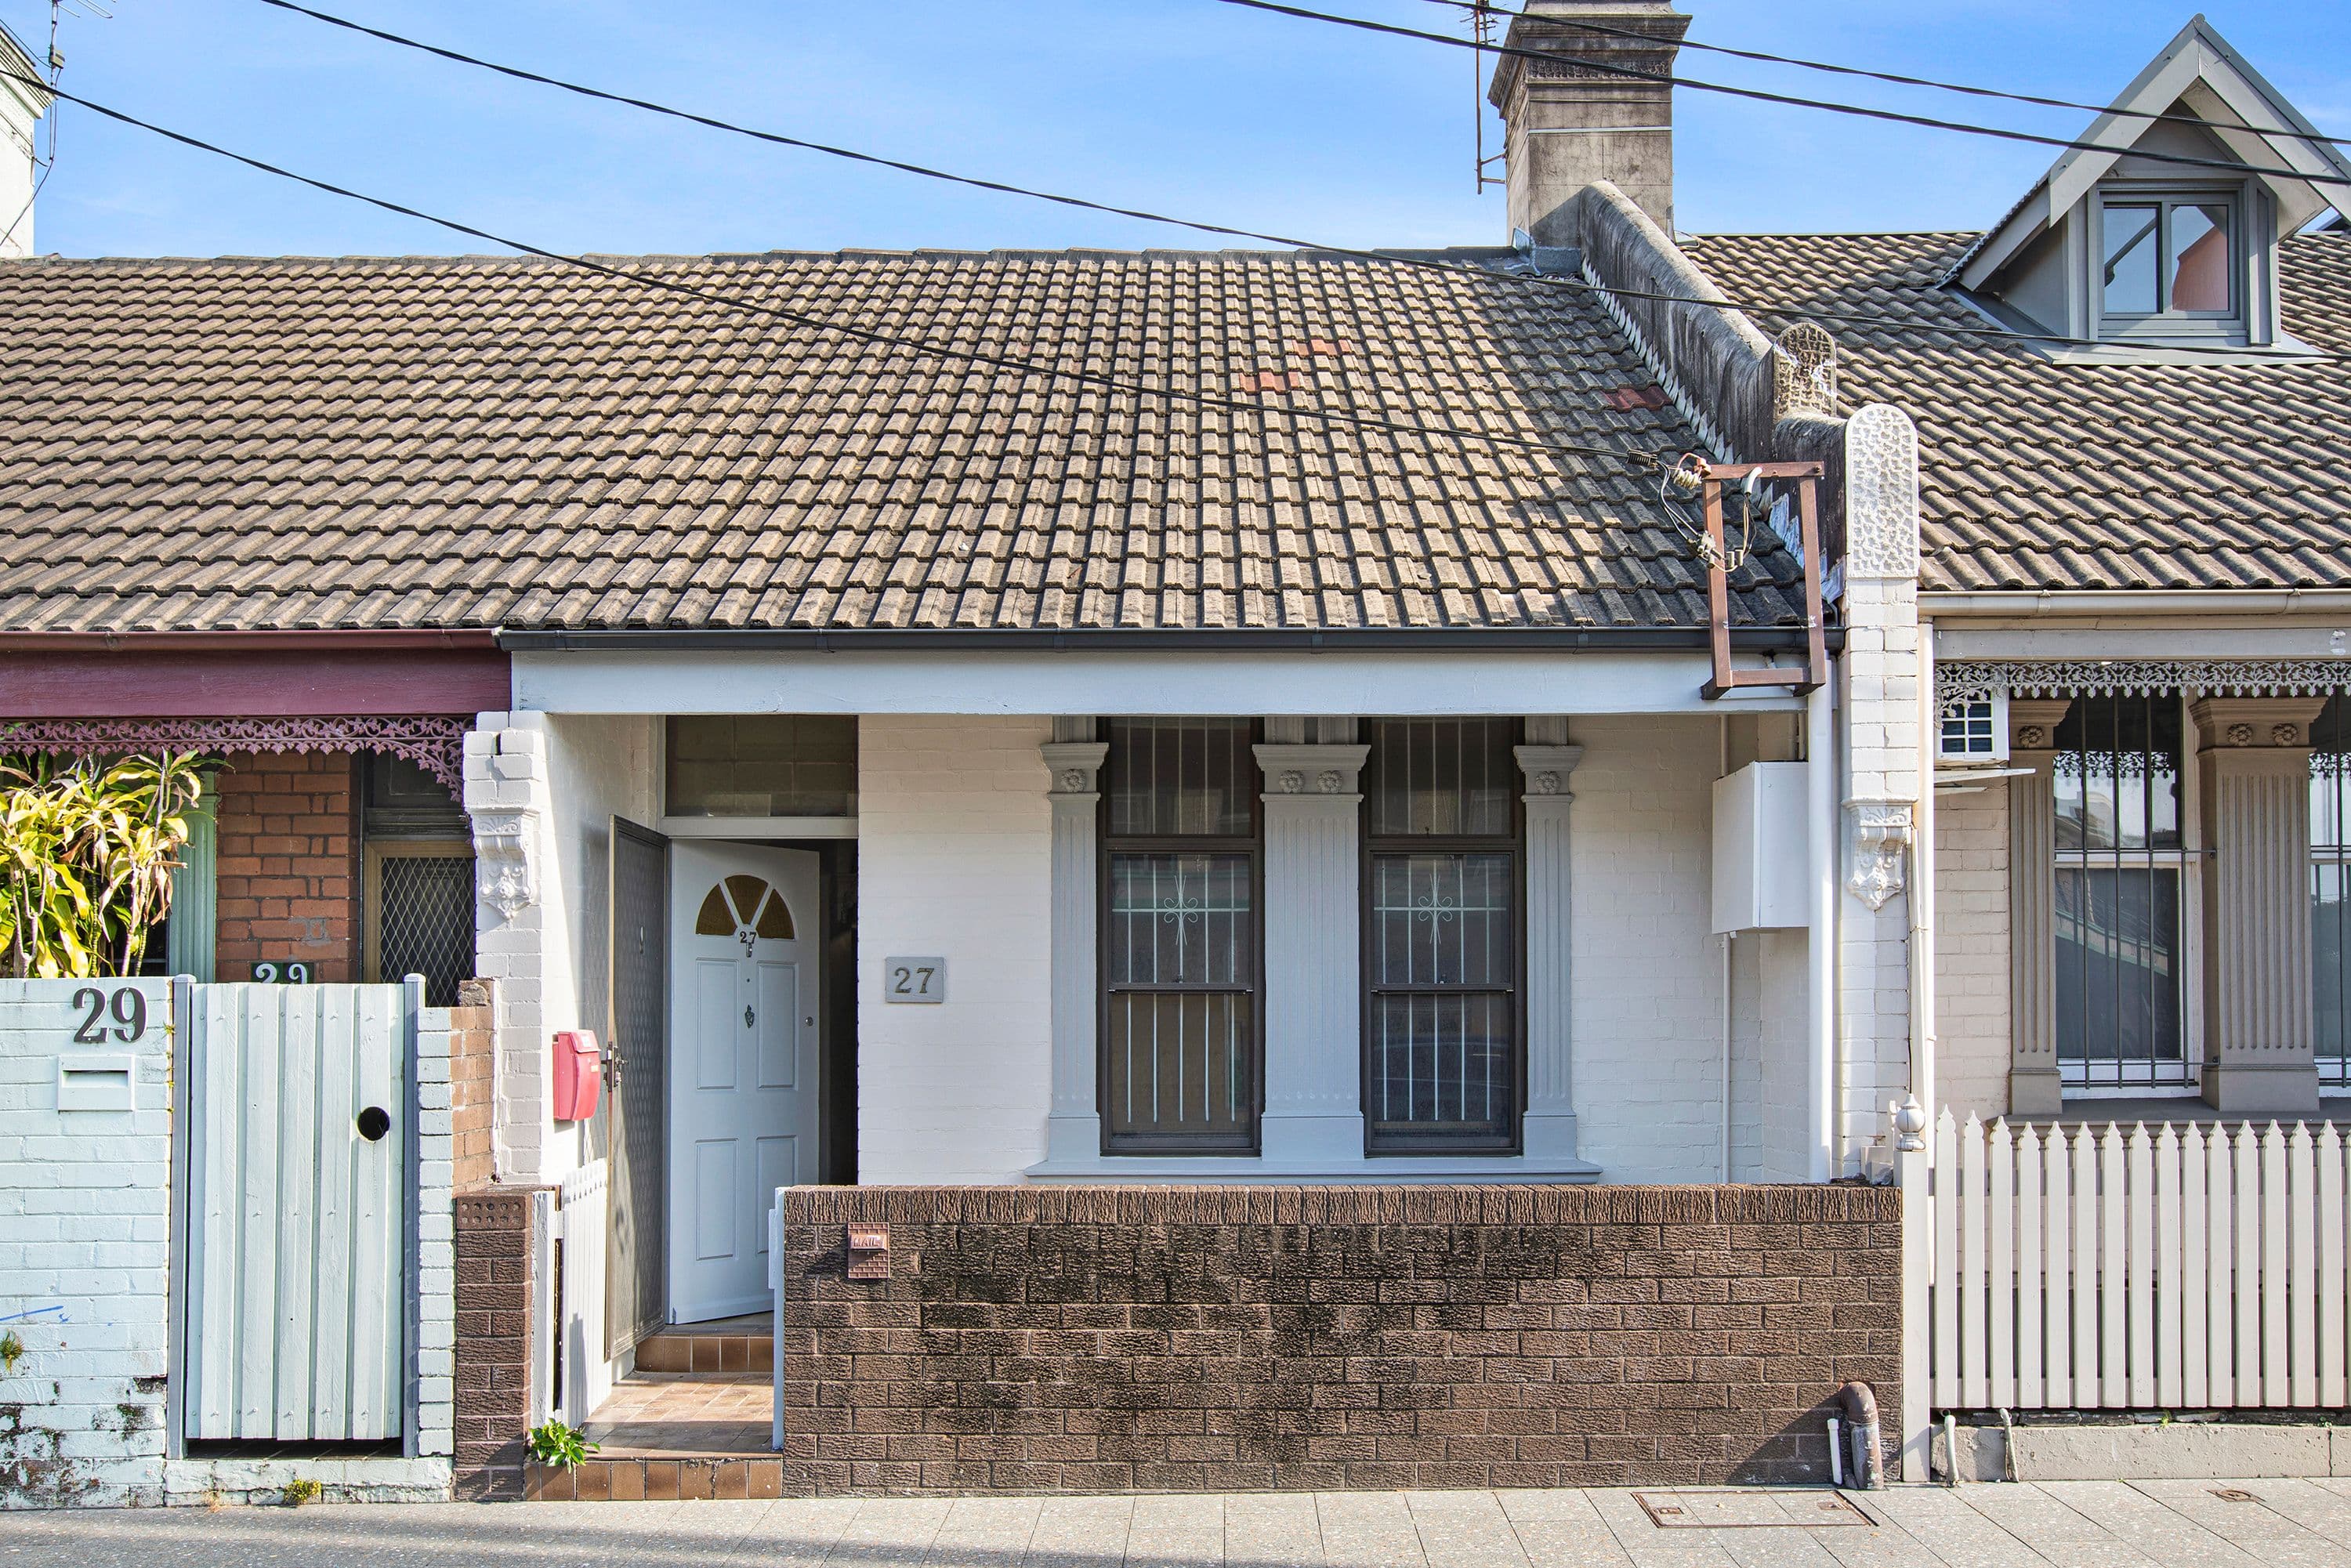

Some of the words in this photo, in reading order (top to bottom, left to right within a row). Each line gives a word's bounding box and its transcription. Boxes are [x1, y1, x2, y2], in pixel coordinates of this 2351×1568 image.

[740, 931, 756, 944] 27
[256, 963, 307, 984] 29
[894, 967, 935, 994] 27
[73, 987, 147, 1043] 29
[853, 1237, 880, 1248] MAIL
